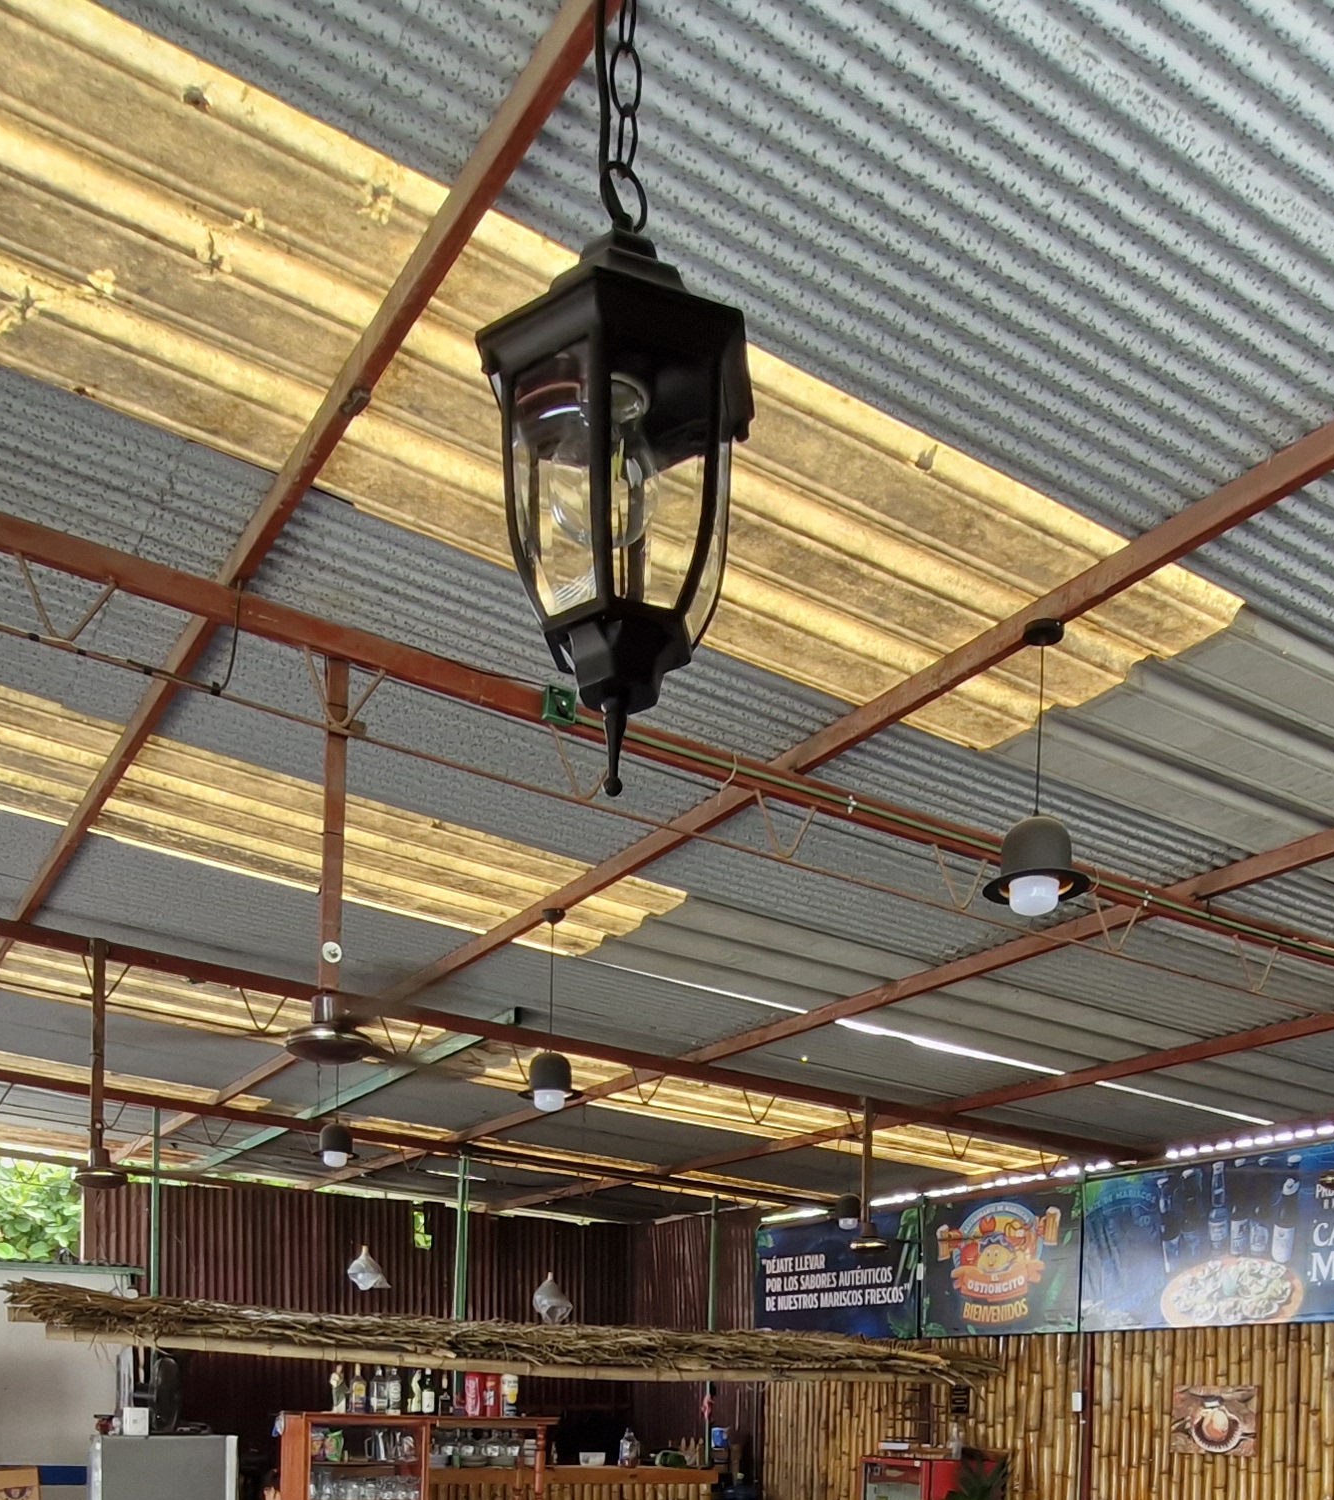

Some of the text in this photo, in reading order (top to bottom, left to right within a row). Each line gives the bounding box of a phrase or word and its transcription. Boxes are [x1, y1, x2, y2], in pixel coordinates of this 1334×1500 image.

[762, 1253, 826, 1275] "DÉJATE LLEVAR
[765, 1265, 893, 1293] POR LOS SABORES AUTÉNTICOS
[967, 1276, 1025, 1295] OSTIONCITO
[765, 1282, 910, 1312] DE NUESTROS MARISCOS FRESCOS"
[963, 1298, 1029, 1323] BIENVENIDOS
